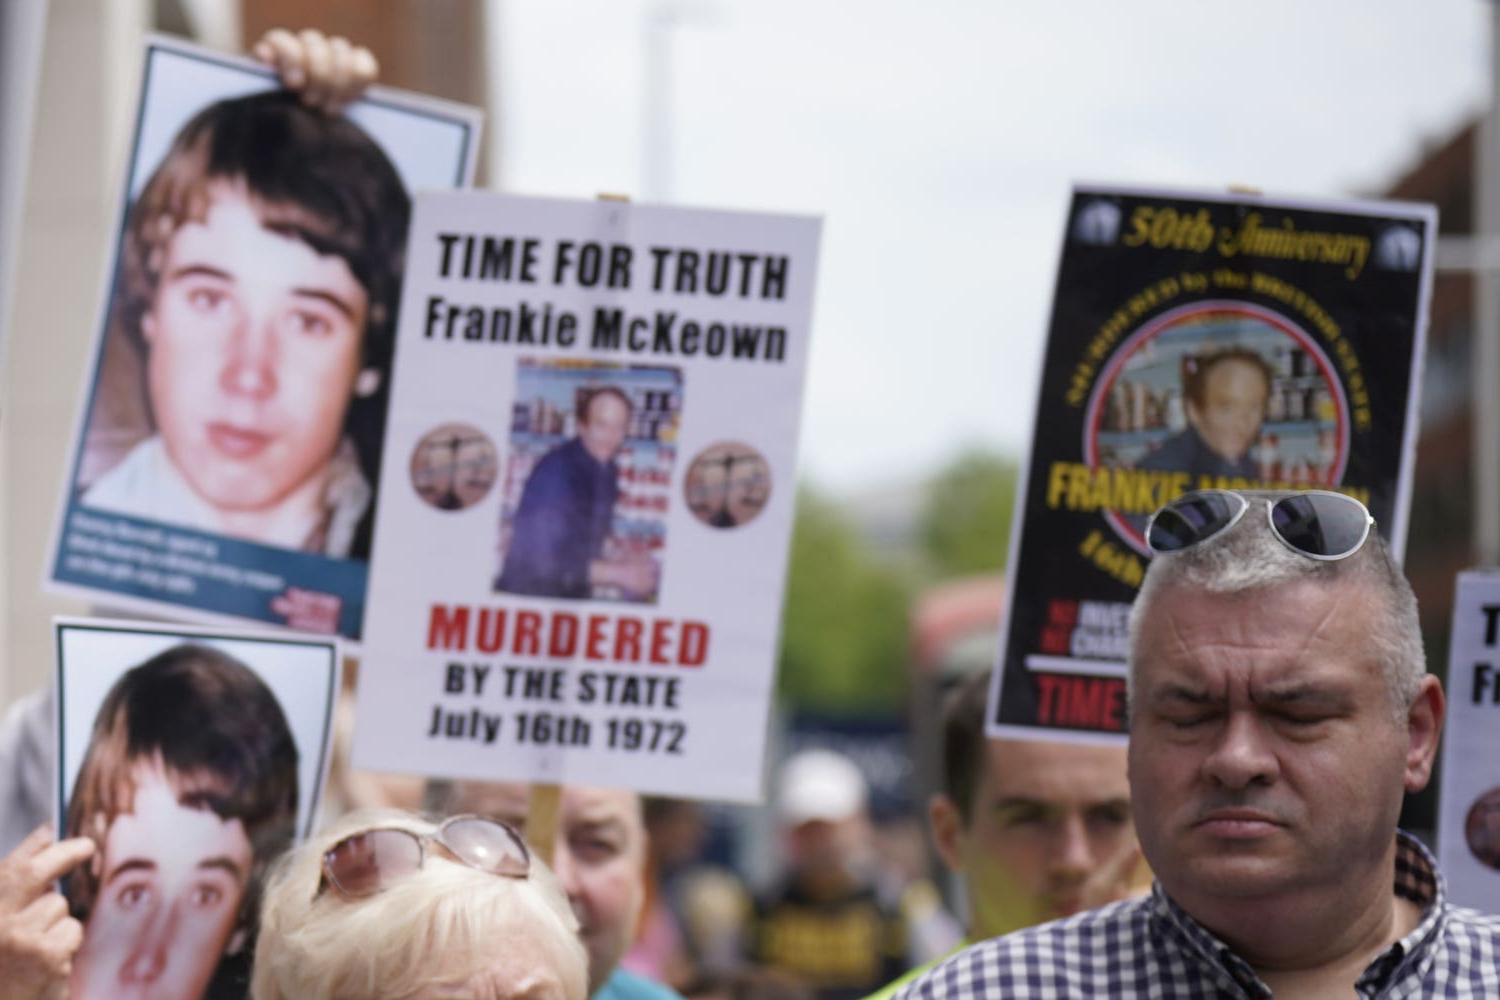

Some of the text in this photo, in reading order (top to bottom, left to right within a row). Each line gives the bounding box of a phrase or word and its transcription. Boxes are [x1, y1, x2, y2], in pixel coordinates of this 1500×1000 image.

[436, 233, 792, 301] TIME FOR TRUTH
[1124, 205, 1372, 280] 50th Anniversary
[423, 298, 789, 363] Frankie McKeown
[1047, 461, 1192, 514] FRANKIE
[426, 605, 711, 669] MURDERED
[444, 664, 683, 710] BY THE STATE
[1037, 673, 1126, 731] TIME
[429, 704, 687, 755] July 16th 1972
